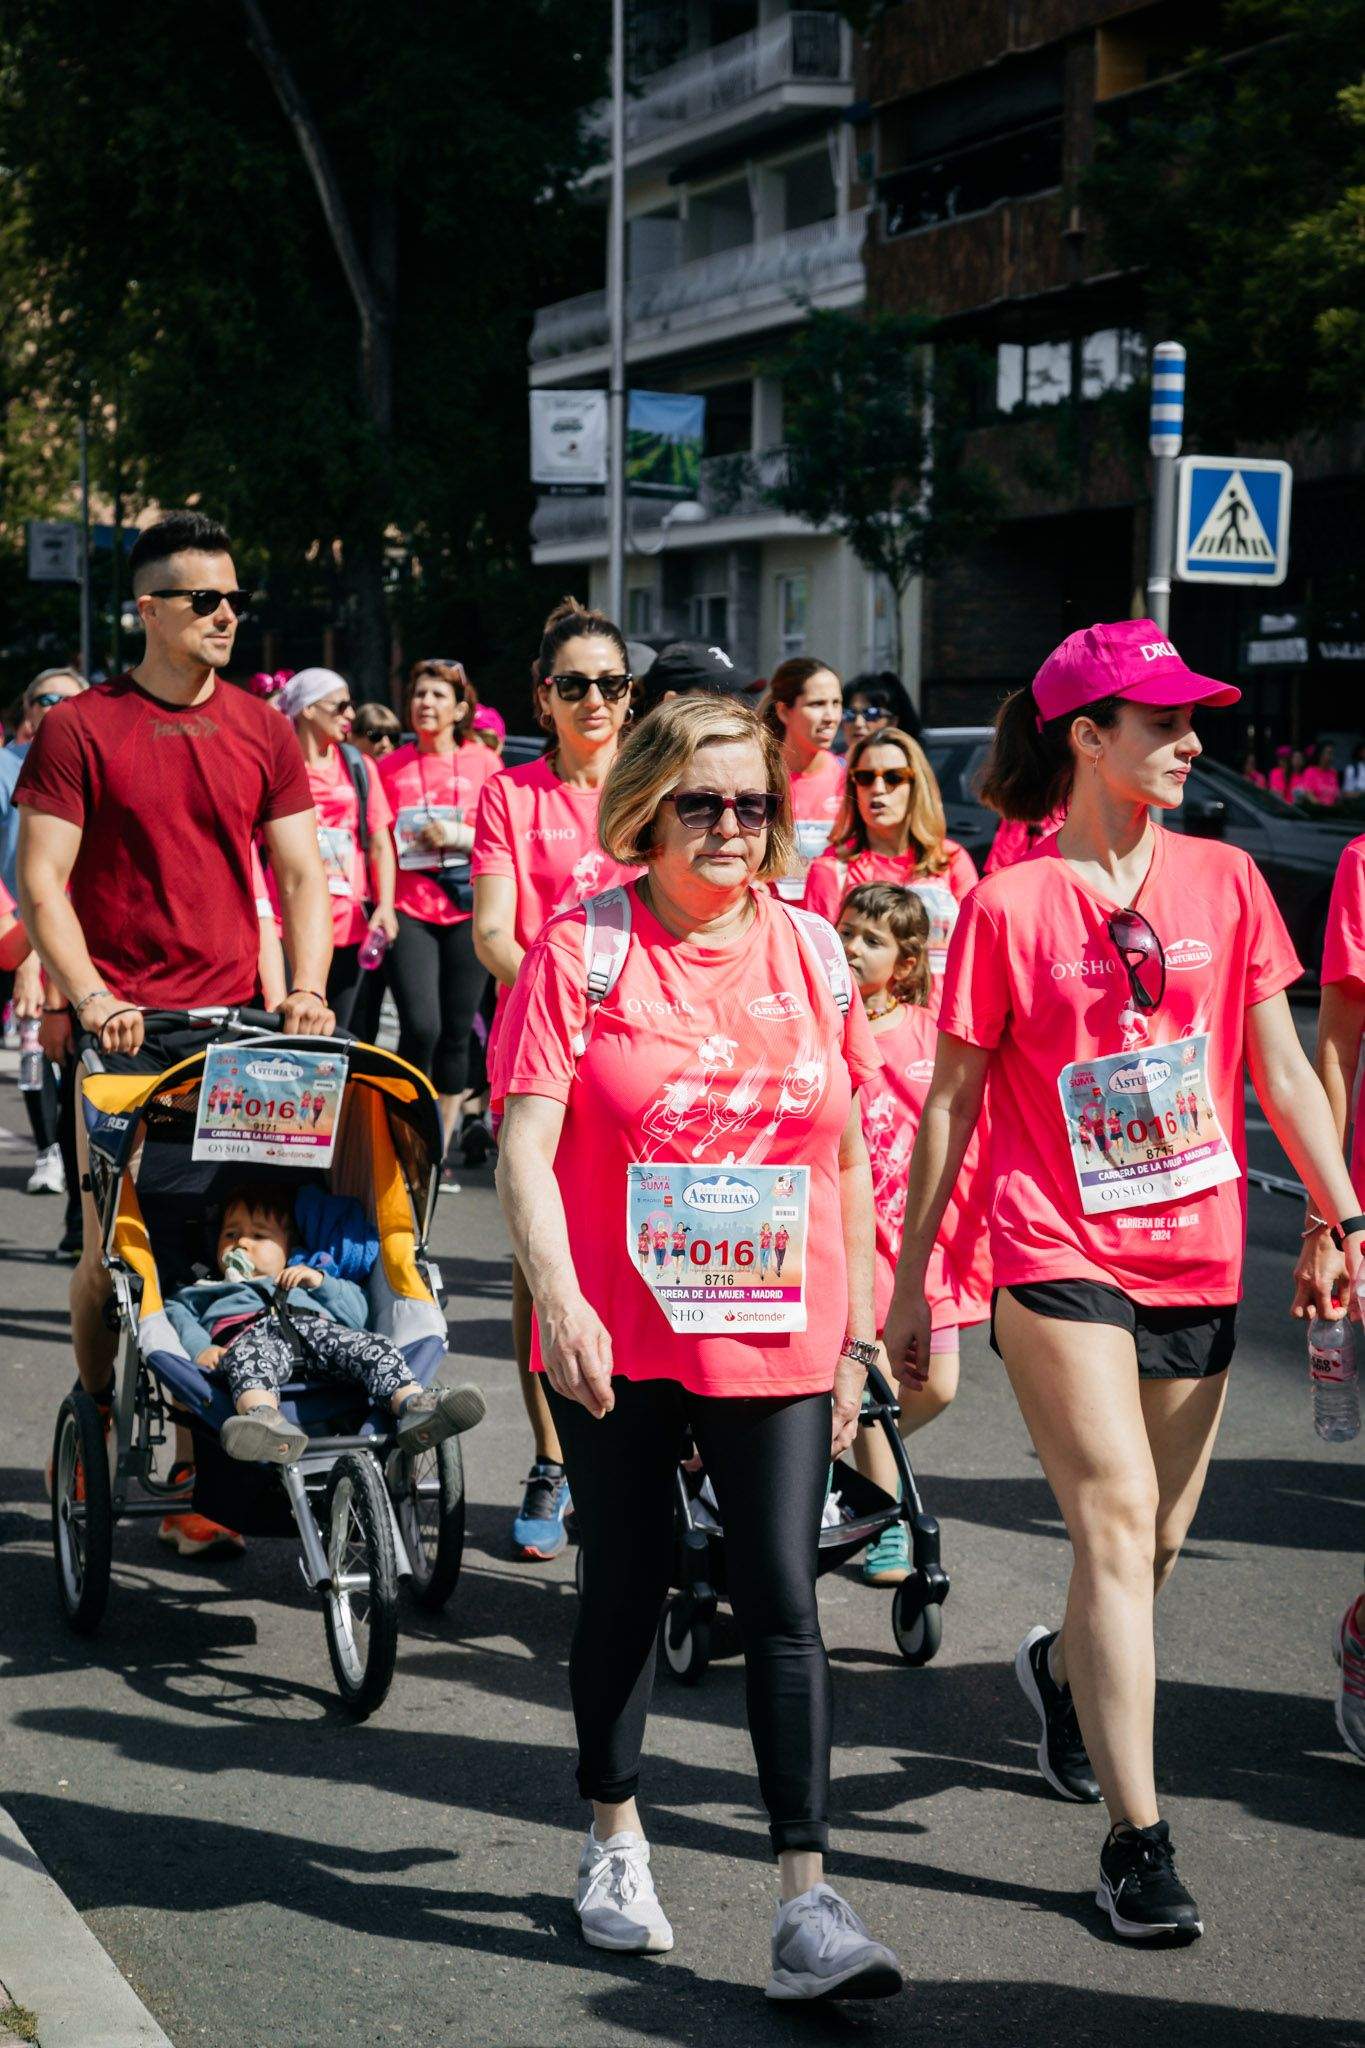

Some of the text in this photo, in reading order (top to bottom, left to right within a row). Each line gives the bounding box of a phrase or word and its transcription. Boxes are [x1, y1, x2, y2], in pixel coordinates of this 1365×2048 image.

[525, 828, 576, 840] OYSHO
[1050, 959, 1116, 980] OYSHO
[245, 1098, 295, 1119] 016
[1126, 1111, 1178, 1144] 016
[208, 1144, 250, 1154] OYSHO
[1098, 1169, 1136, 1181] CARRERA
[1137, 1165, 1149, 1174] DE
[1150, 1162, 1162, 1172] LA
[640, 1181, 670, 1191] SUMA
[1101, 1182, 1154, 1201] OYSHO
[688, 1188, 755, 1204] ASTURIANA
[1116, 1217, 1153, 1229] CARRERA
[1154, 1217, 1165, 1228] DE
[1166, 1217, 1177, 1228] LA
[1150, 1229, 1171, 1241] 2024
[689, 1239, 755, 1267] 016
[704, 1274, 734, 1286] 8716
[691, 1289, 703, 1299] DE
[705, 1289, 717, 1299] LA
[718, 1289, 745, 1299] MUJER
[751, 1289, 783, 1299] MADRID
[736, 1311, 786, 1322] Santander
